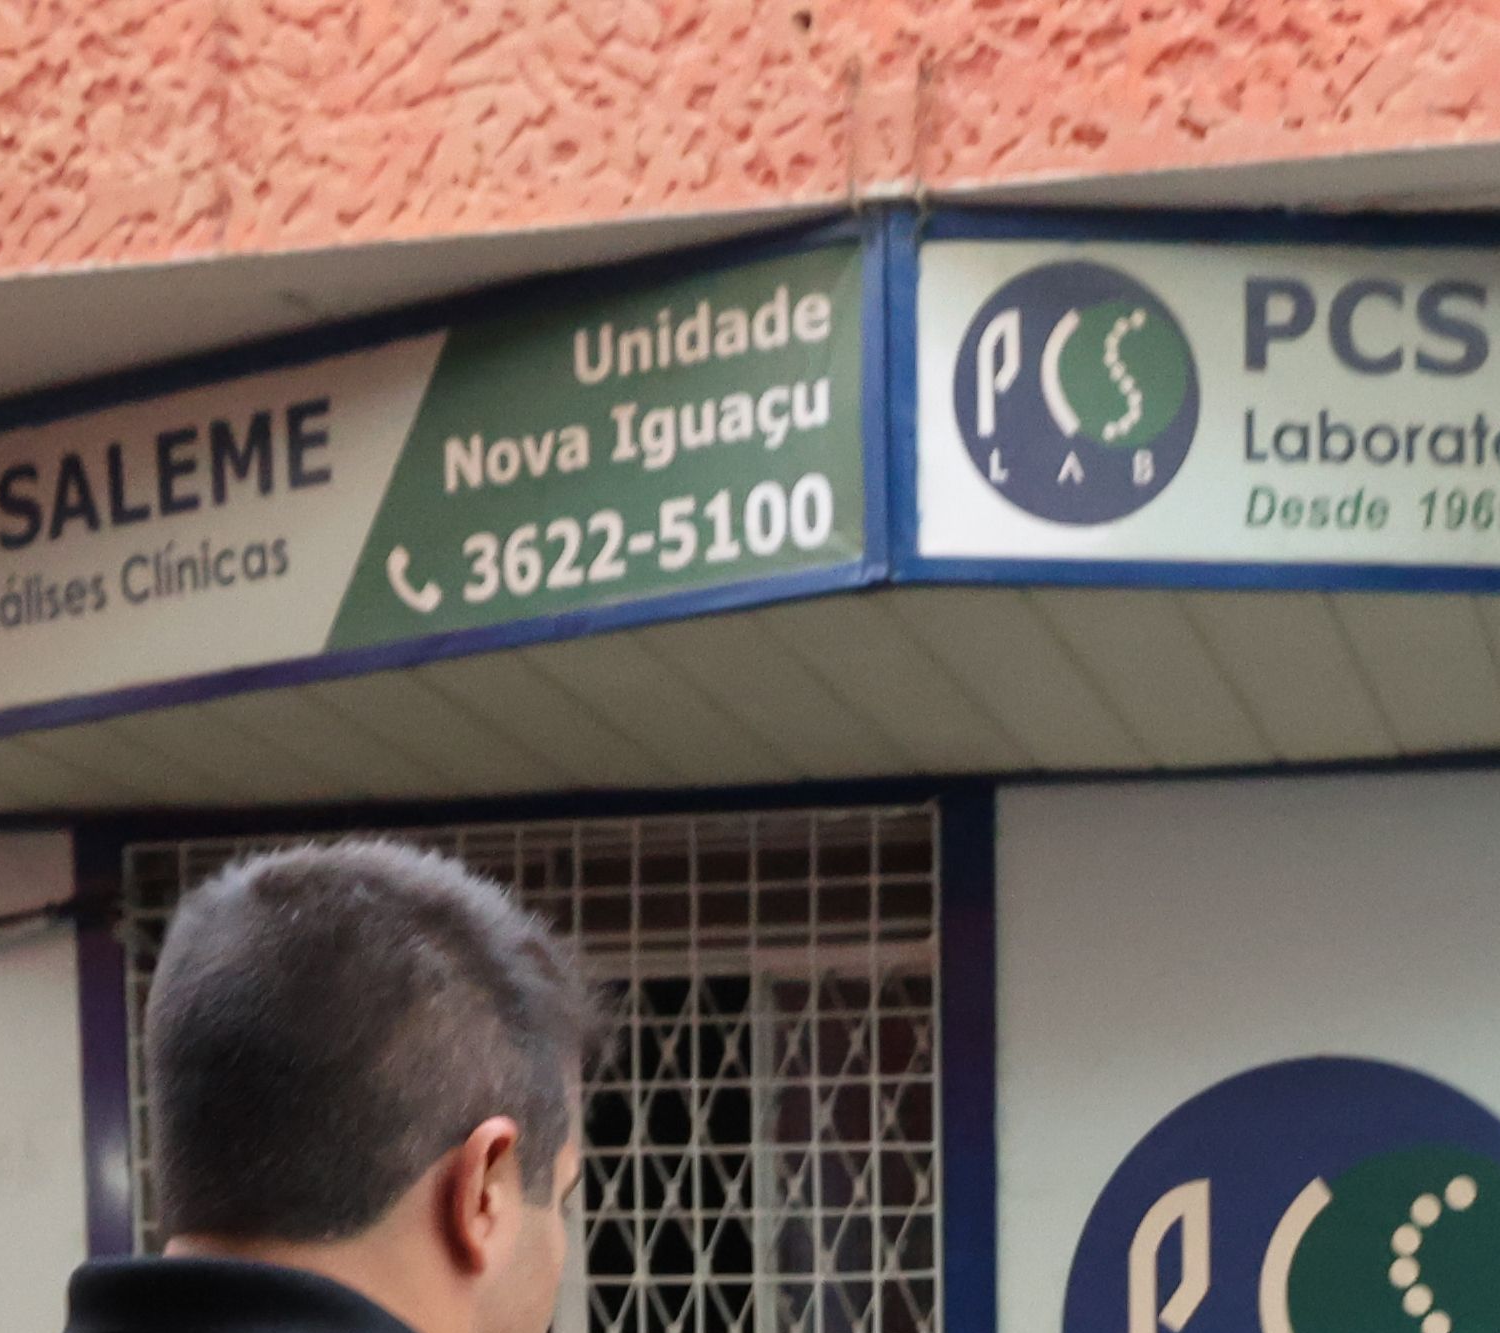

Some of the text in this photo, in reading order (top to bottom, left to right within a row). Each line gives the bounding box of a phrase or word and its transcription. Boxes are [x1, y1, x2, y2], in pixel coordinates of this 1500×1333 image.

[573, 284, 832, 384] Unidade
[978, 306, 1147, 441] PCS
[1243, 277, 1490, 377] PCS
[444, 377, 831, 493] Nova Iguaçu
[462, 472, 834, 602] 3622-5100
[1245, 486, 1389, 529] Desde
[120, 537, 289, 603] Clínicas
